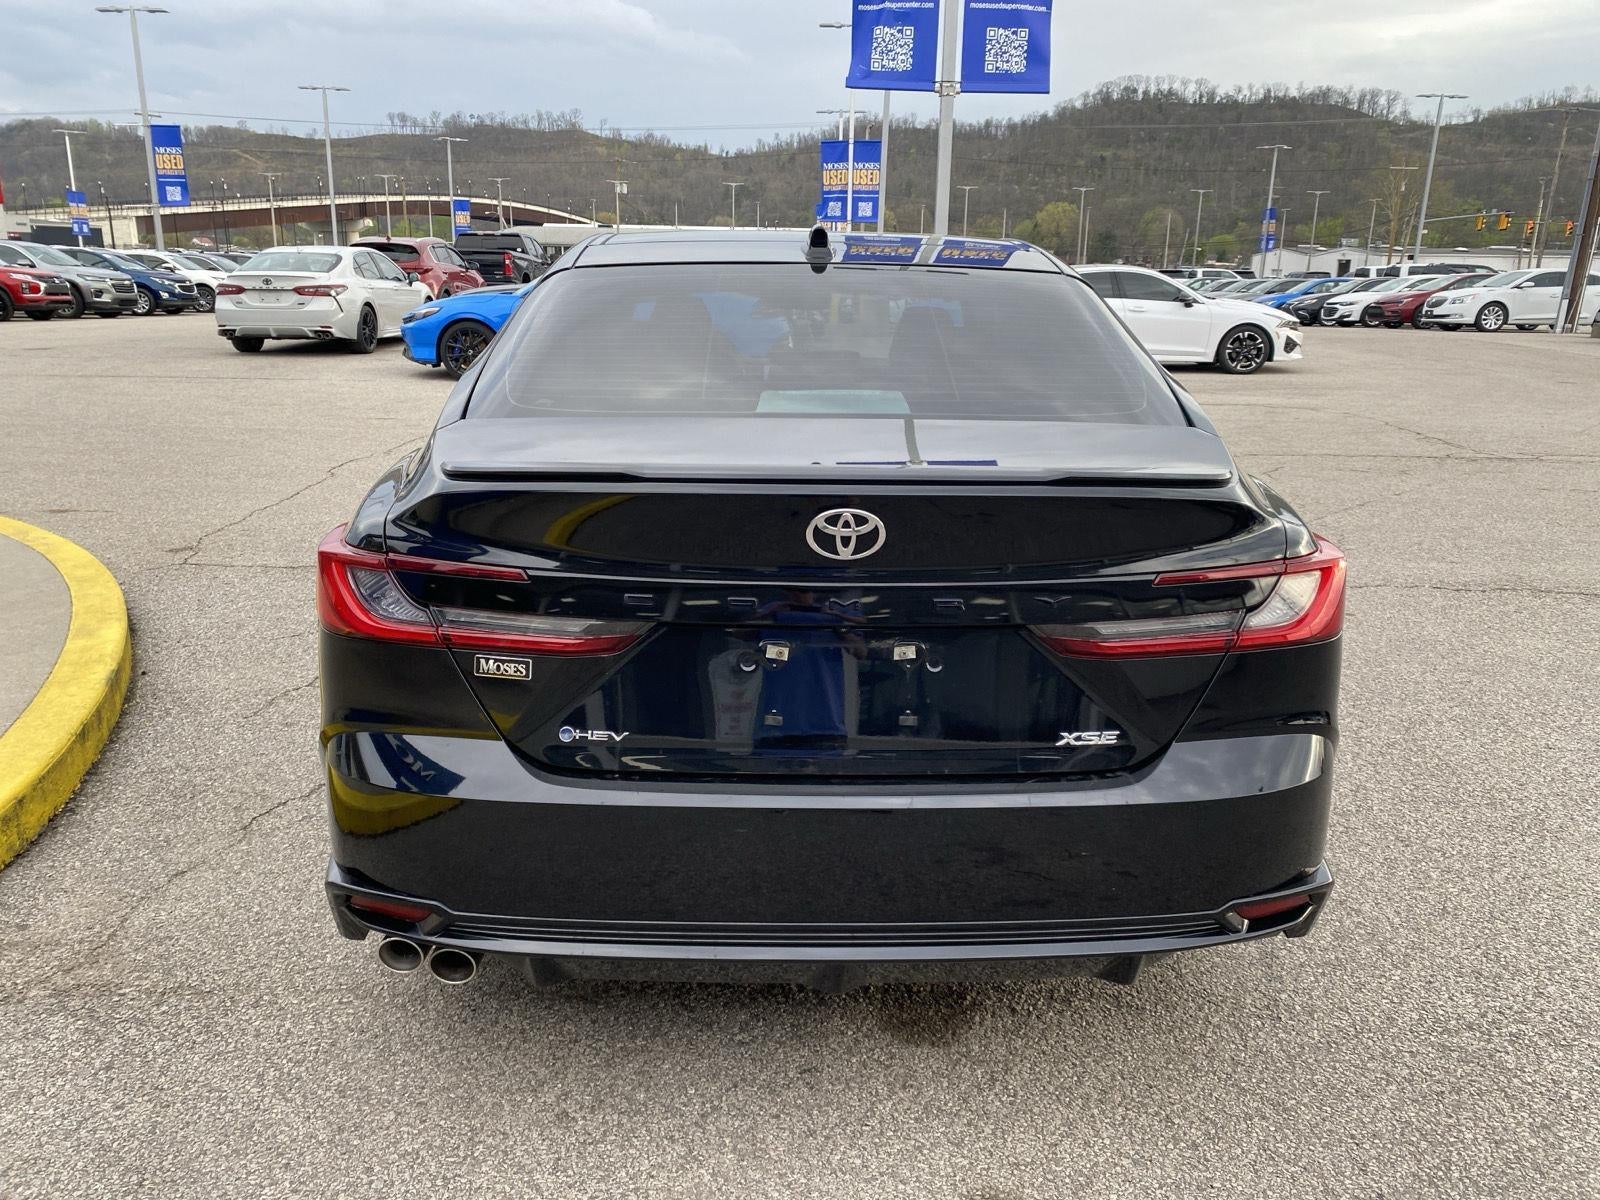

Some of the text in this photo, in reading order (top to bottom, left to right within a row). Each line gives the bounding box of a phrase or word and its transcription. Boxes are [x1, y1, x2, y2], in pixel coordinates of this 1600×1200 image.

[858, 1, 935, 11] mosesusedsupercenter.com
[970, 2, 1047, 12] mosesusedsupercenter.com
[155, 146, 182, 154] MOSES
[155, 153, 184, 170] USED
[854, 162, 880, 170] MOSES
[822, 169, 849, 186] USED
[853, 169, 880, 185] USED
[479, 658, 527, 677] MOSES
[1055, 730, 1121, 746] XSE
